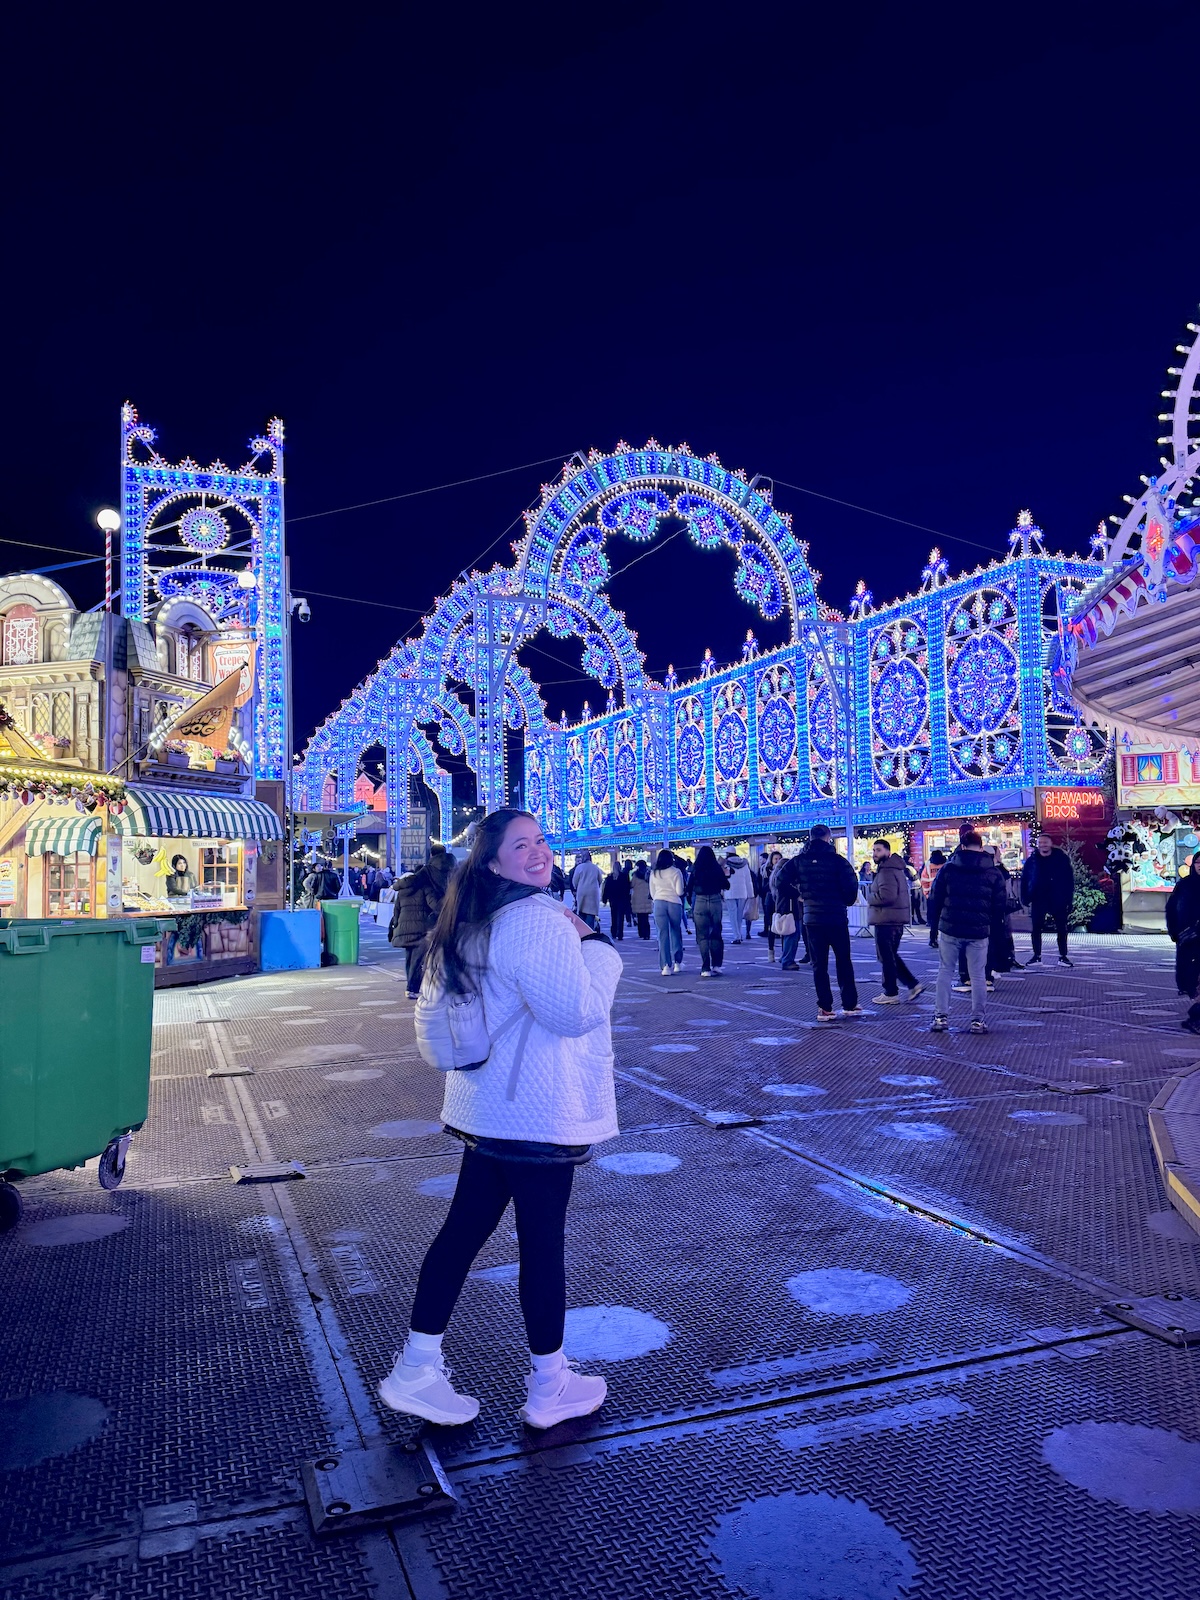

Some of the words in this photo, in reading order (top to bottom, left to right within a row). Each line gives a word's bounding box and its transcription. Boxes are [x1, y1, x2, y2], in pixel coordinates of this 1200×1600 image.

[219, 656, 246, 667] Crepes
[181, 723, 216, 737] DOG
[1045, 791, 1104, 805] SHAWARMA
